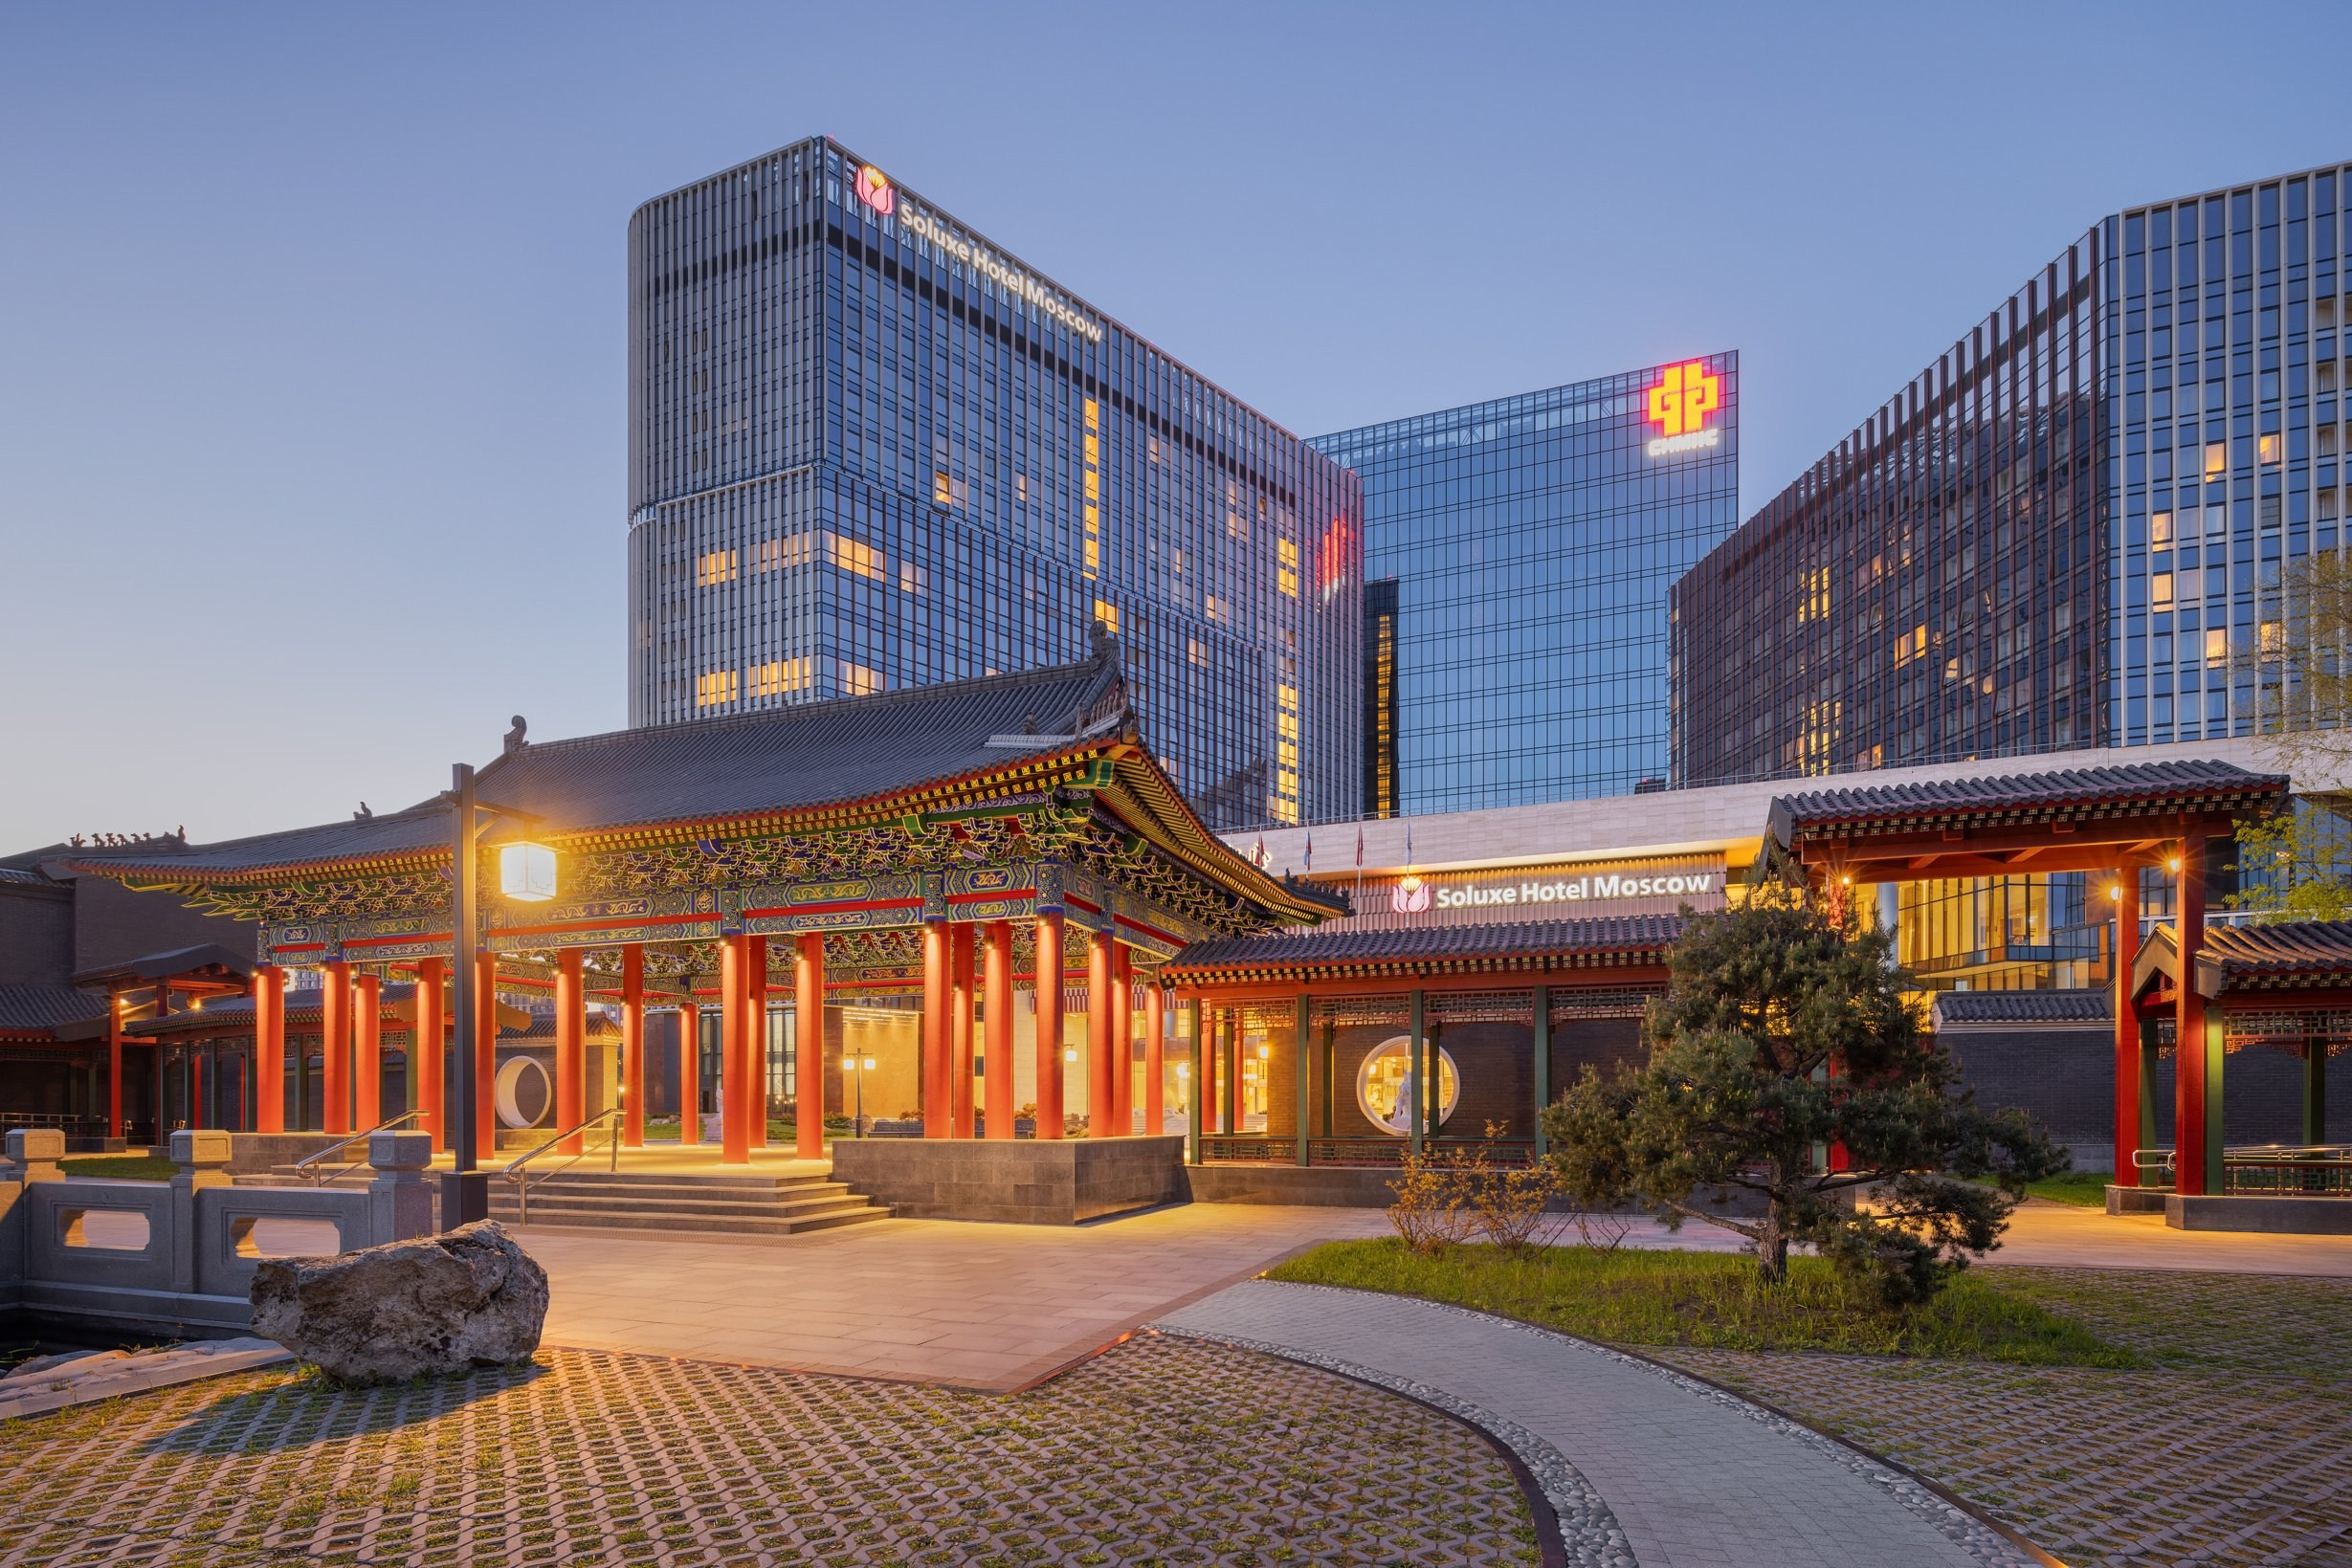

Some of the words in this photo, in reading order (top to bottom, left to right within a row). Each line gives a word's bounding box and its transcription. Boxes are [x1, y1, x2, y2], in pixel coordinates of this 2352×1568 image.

[901, 204, 968, 260] Soluxe
[973, 248, 1023, 295] Hotel
[1026, 280, 1101, 342] Moscow
[1437, 885, 1516, 907] Soluxe
[1521, 877, 1586, 902] Hotel
[1594, 875, 1709, 897] Moscow
